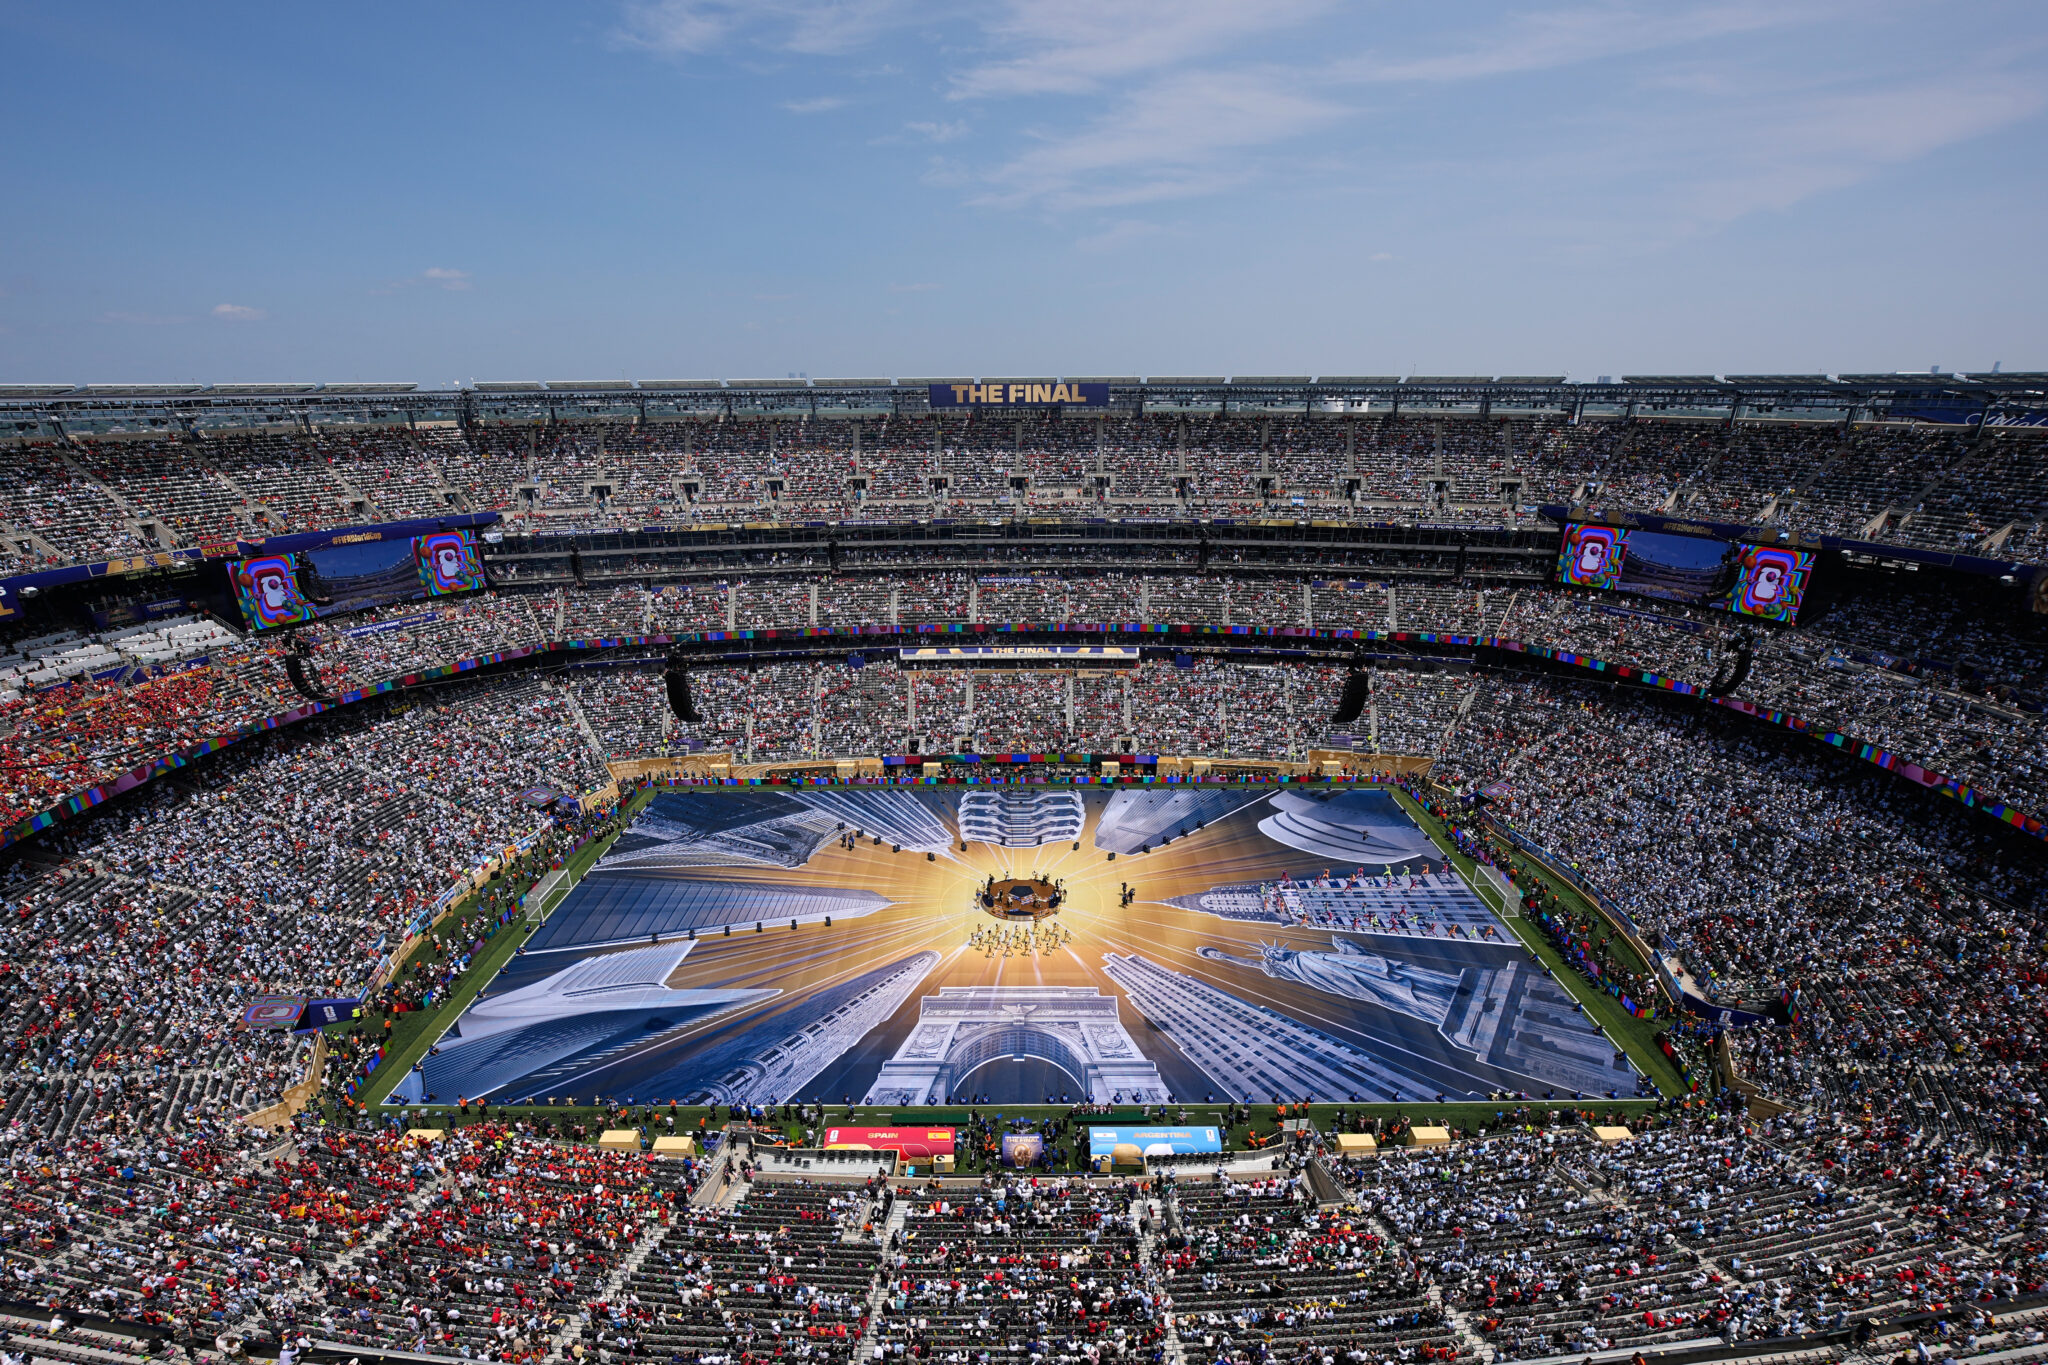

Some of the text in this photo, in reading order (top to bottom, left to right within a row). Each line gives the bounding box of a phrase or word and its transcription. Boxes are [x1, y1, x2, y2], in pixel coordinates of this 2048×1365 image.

[951, 384, 1087, 403] THE FINAL
[149, 604, 162, 612] THE
[162, 602, 181, 610] FINAL
